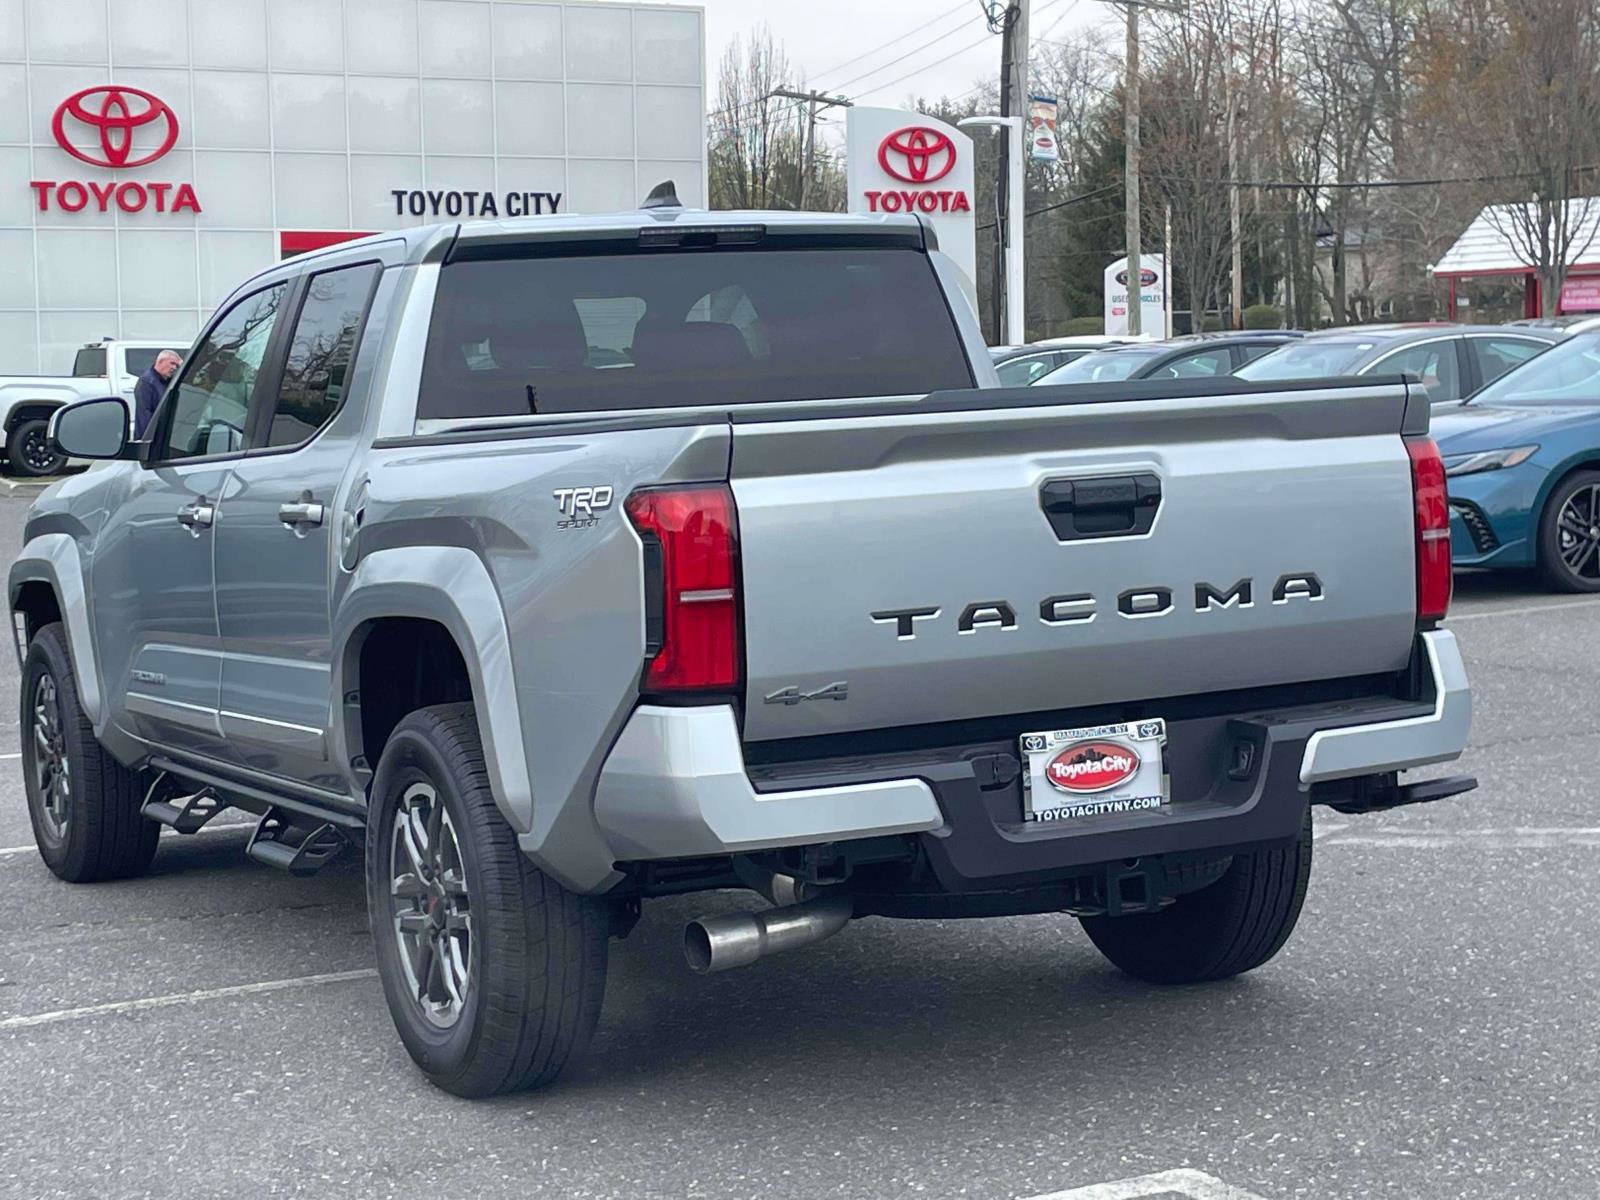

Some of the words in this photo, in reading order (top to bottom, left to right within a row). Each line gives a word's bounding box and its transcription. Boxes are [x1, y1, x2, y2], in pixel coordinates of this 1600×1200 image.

[30, 181, 201, 212] TOYOTA
[391, 190, 498, 216] TOYOTA
[506, 192, 562, 216] CITY
[864, 191, 970, 213] TOYOTA
[553, 486, 613, 518] TRD
[557, 518, 601, 530] SPORT
[870, 572, 1325, 641] TACOMA
[1035, 797, 1161, 822] TOYOTACITYNY.COM
